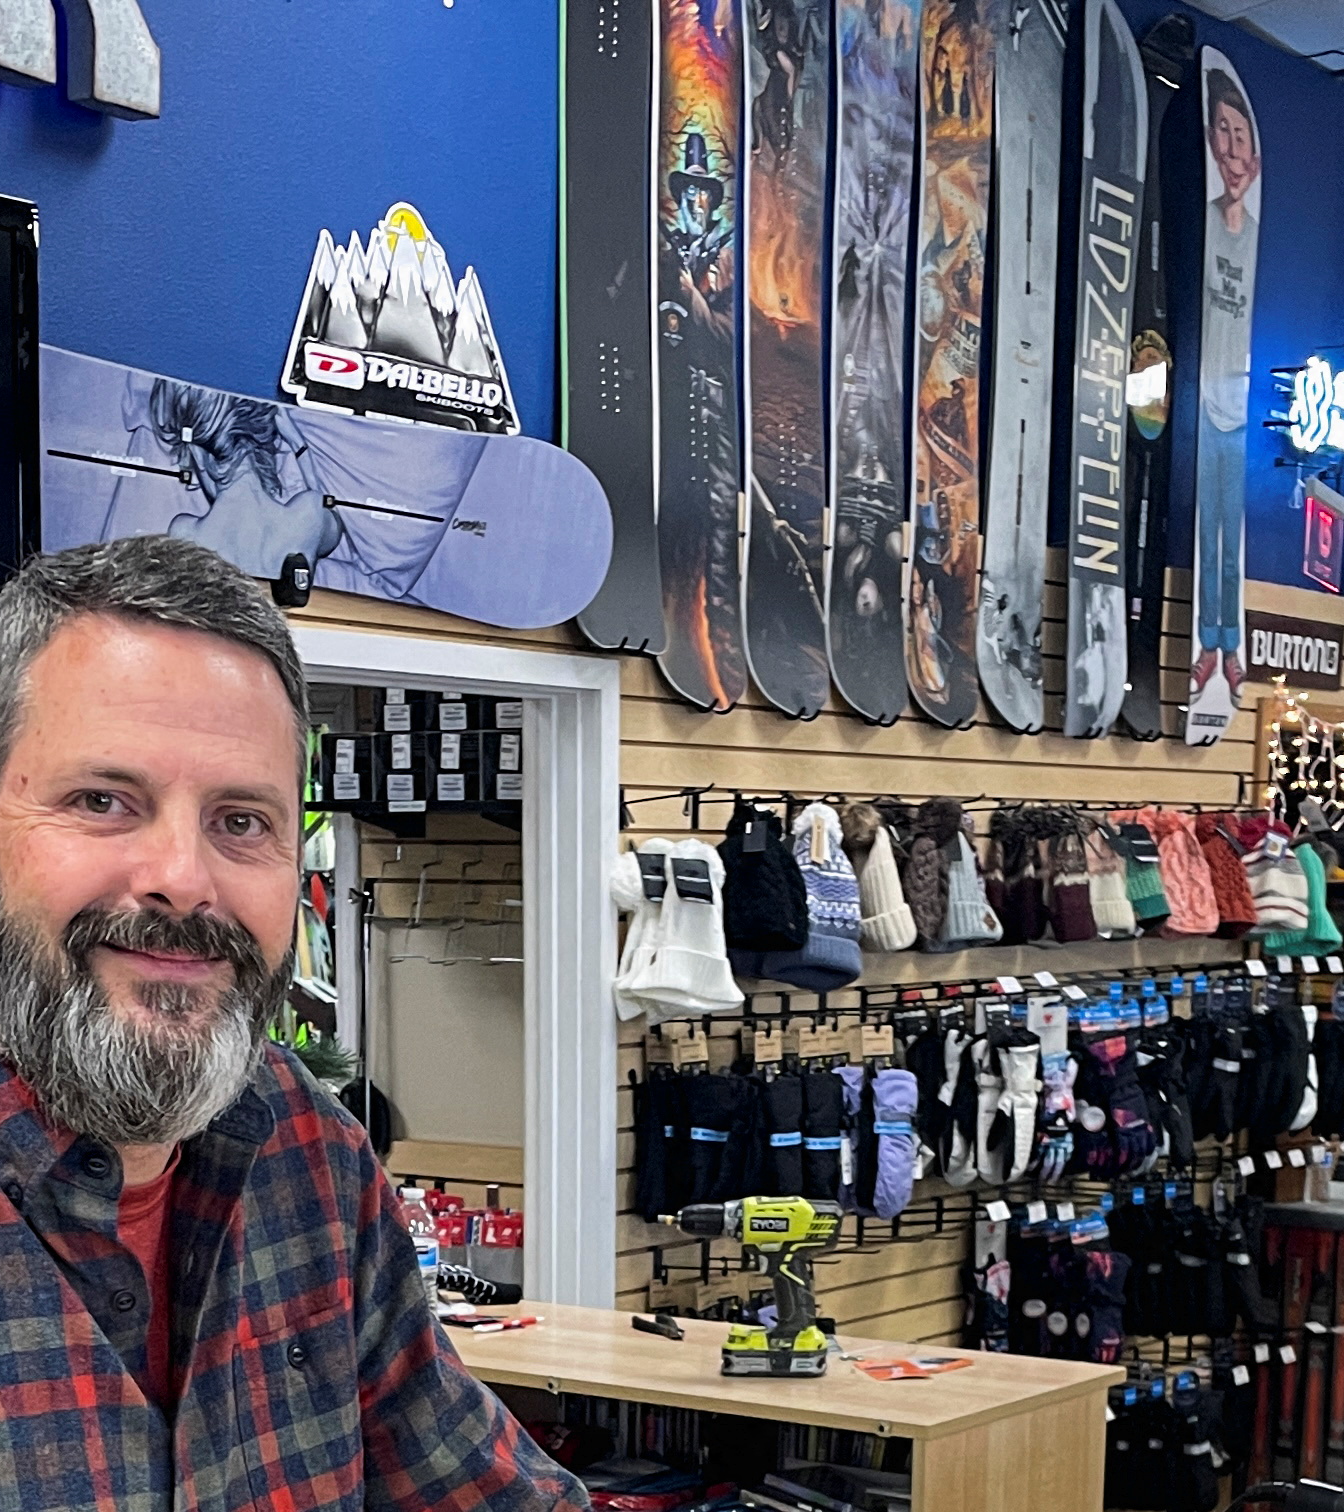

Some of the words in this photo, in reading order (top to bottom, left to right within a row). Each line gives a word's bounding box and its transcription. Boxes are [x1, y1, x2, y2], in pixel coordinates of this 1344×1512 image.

[363, 355, 504, 409] DALBELLO
[415, 392, 495, 417] SKIBOOTS
[1250, 628, 1331, 675] BURTON
